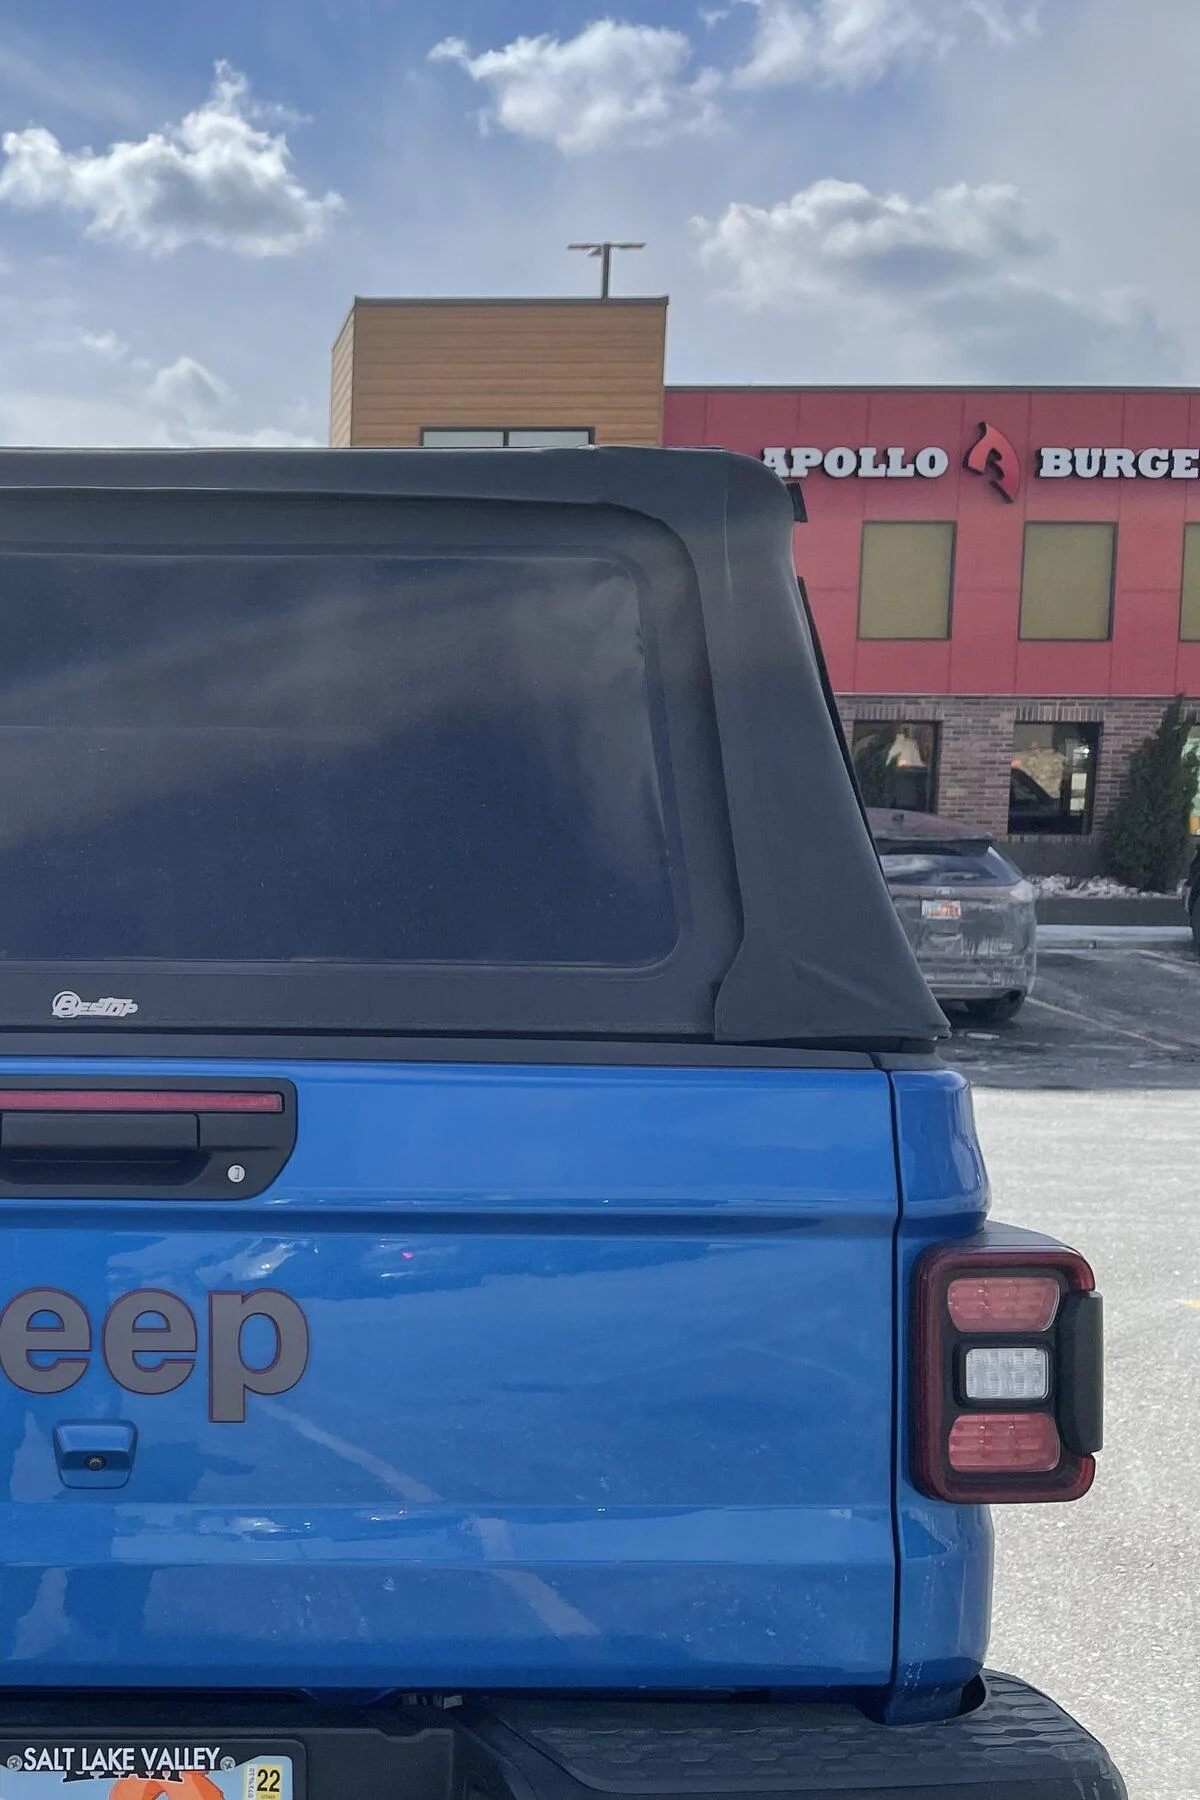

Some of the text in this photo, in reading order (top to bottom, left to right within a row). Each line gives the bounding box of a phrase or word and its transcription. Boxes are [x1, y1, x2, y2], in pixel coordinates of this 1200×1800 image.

[763, 446, 1200, 479] APOLLO BURGE
[23, 1747, 221, 1771] SALT LAKE VALLEY
[256, 1768, 281, 1793] 22
